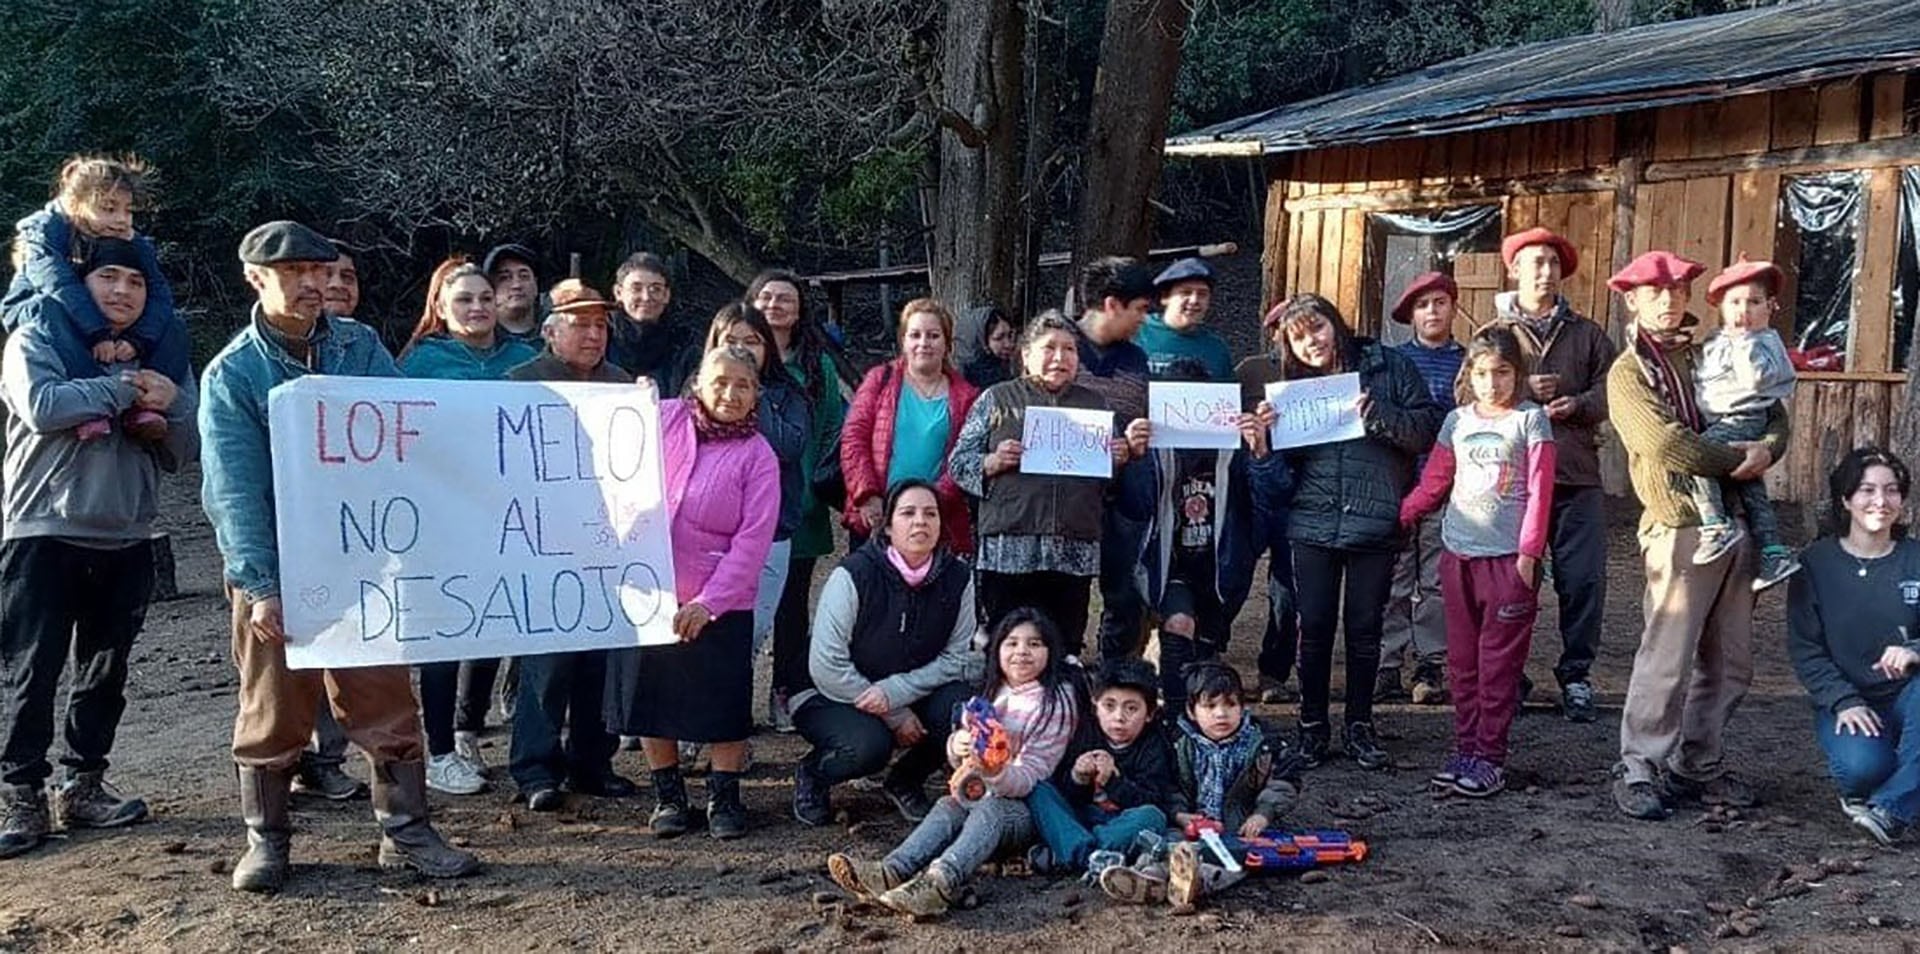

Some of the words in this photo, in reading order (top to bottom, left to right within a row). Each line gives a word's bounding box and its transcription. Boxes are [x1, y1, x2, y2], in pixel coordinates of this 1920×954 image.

[316, 400, 436, 463] LOF
[497, 403, 645, 482] MELO
[1163, 399, 1211, 425] NO
[340, 497, 419, 555] NO
[500, 497, 573, 556] AL
[360, 562, 662, 643] DESALOJO
